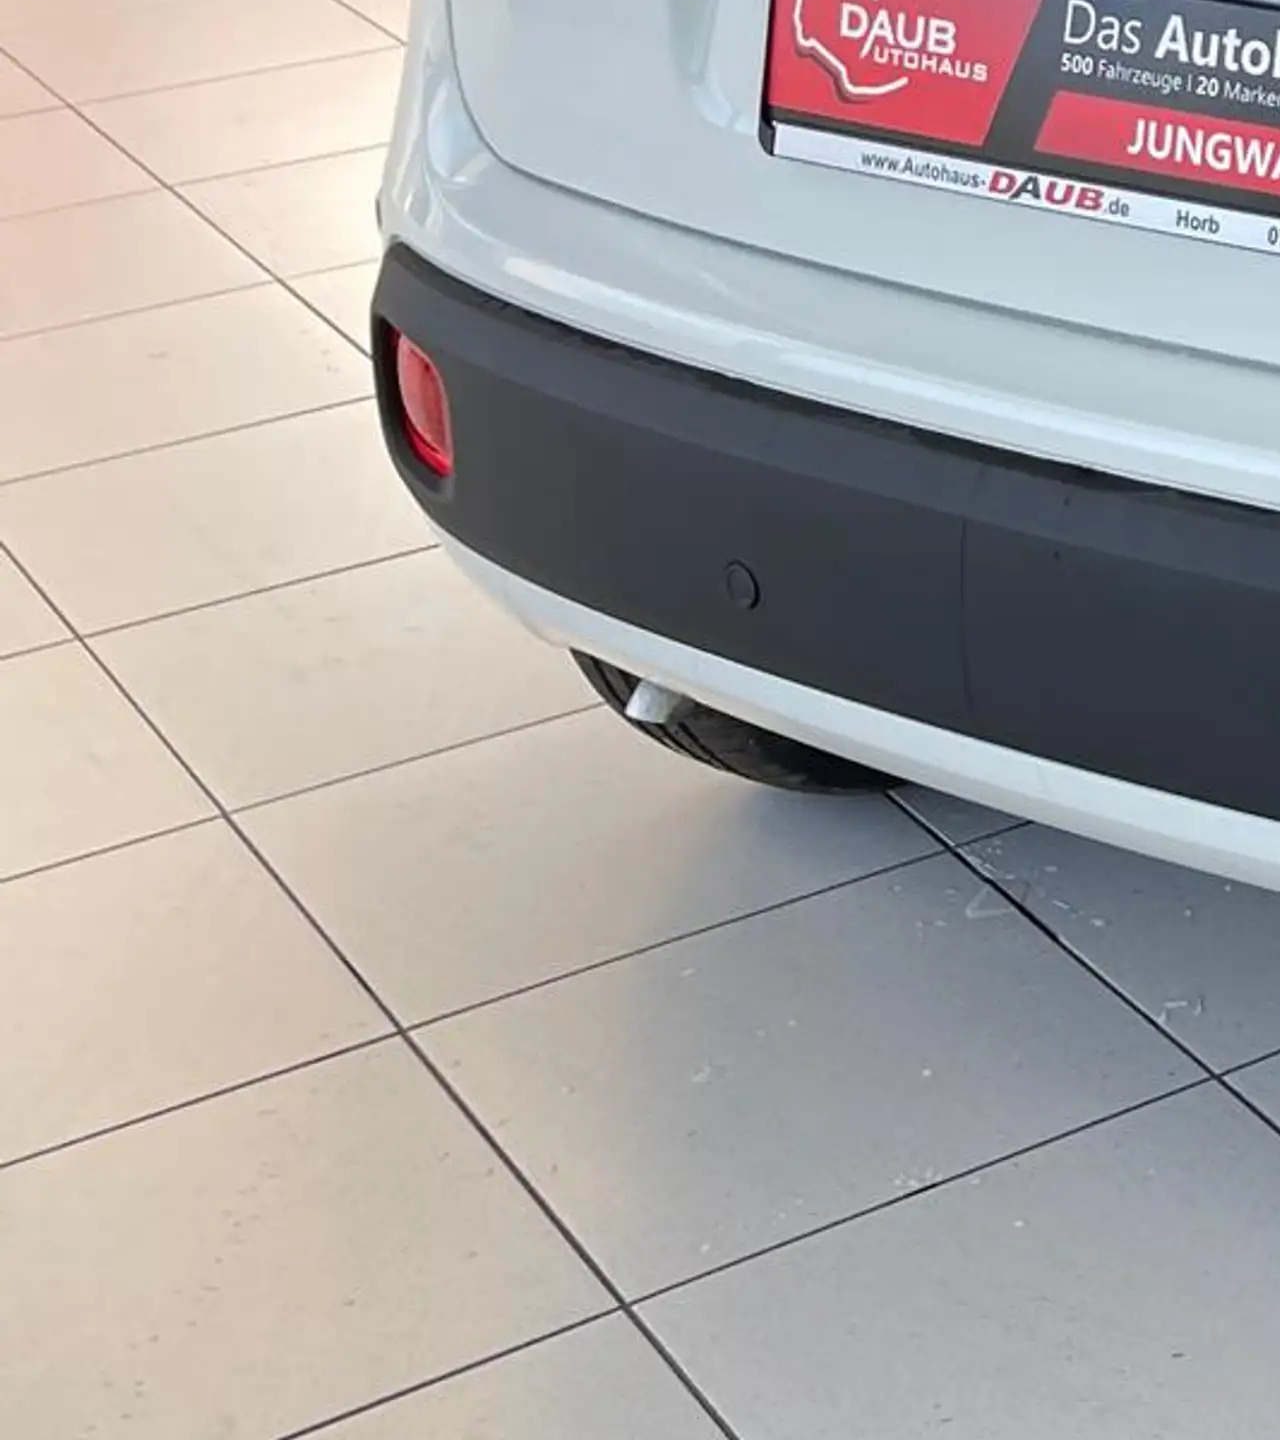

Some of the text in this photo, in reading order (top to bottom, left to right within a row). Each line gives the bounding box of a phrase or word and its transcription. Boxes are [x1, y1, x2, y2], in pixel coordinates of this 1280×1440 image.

[839, 2, 957, 58] DAUB
[1061, 52, 1093, 76] 500
[1097, 59, 1182, 94] Fahrzeuge
[1195, 76, 1219, 97] 20
[861, 150, 1131, 218] www.Autohaus-DAUB.de
[1176, 209, 1220, 235] Horb
